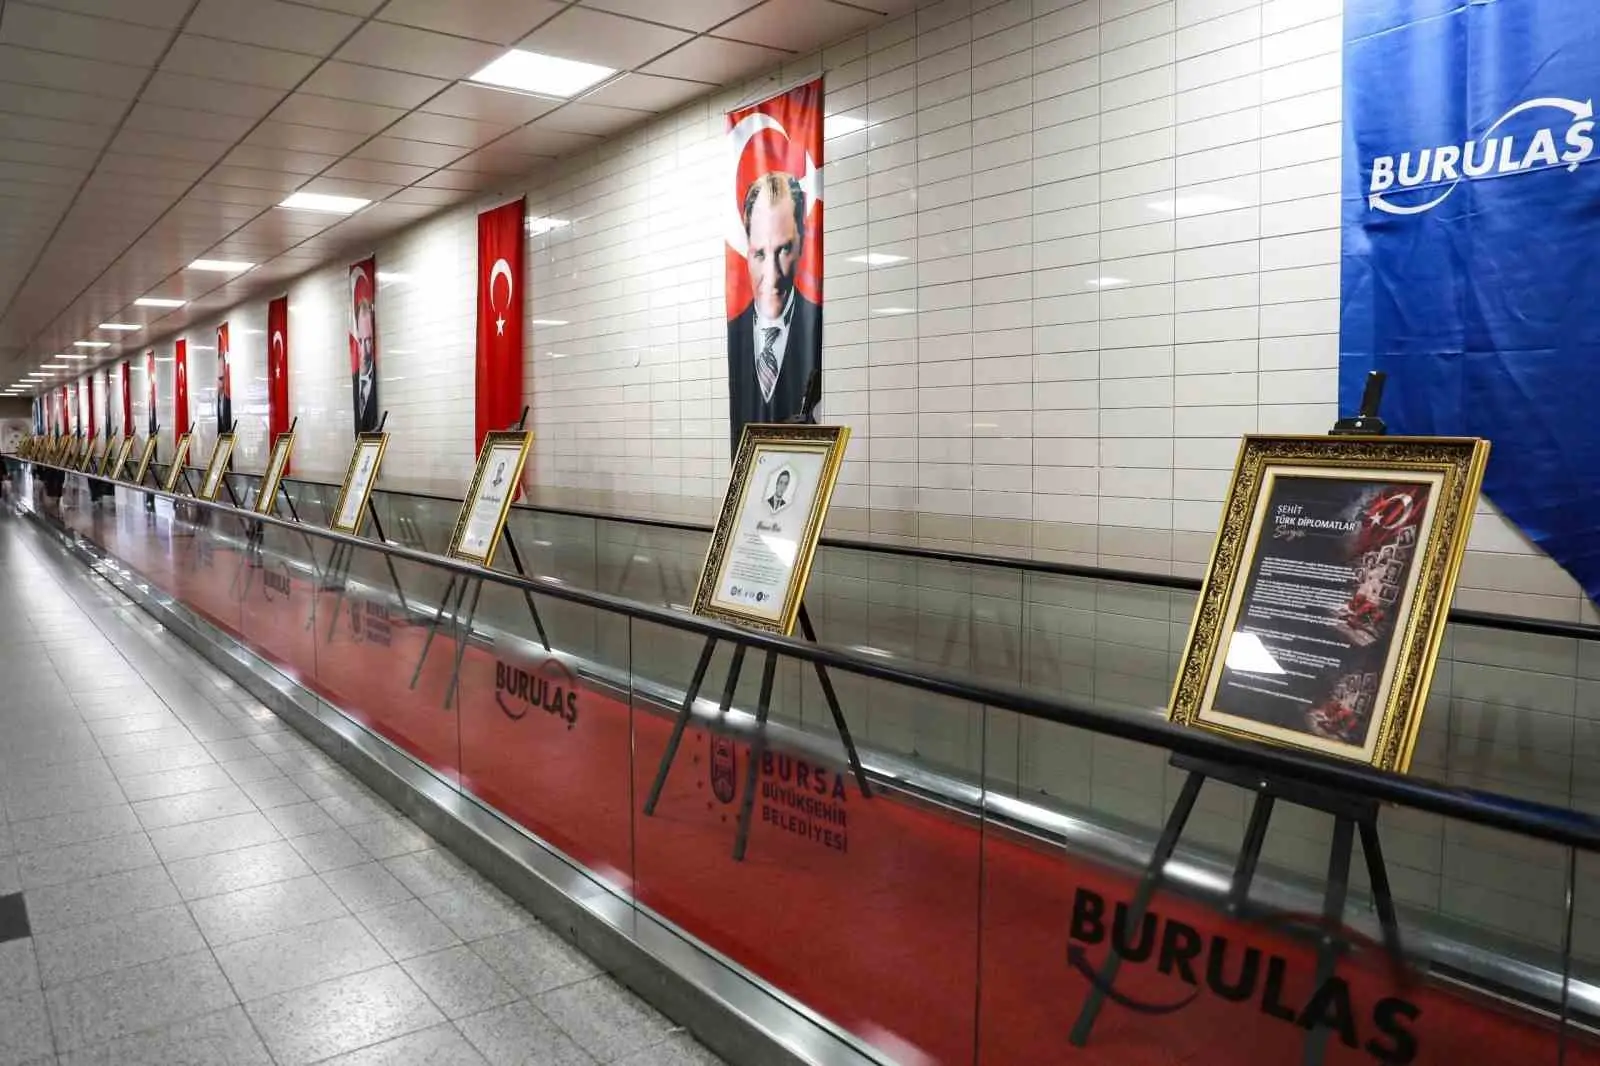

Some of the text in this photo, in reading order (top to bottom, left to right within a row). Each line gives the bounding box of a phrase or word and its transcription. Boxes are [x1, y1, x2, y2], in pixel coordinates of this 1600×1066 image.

[1370, 121, 1595, 191] BURULAŞ
[1275, 515, 1297, 526] TÜRK
[496, 660, 577, 730] BURULAŞ
[762, 750, 846, 801] BURSA
